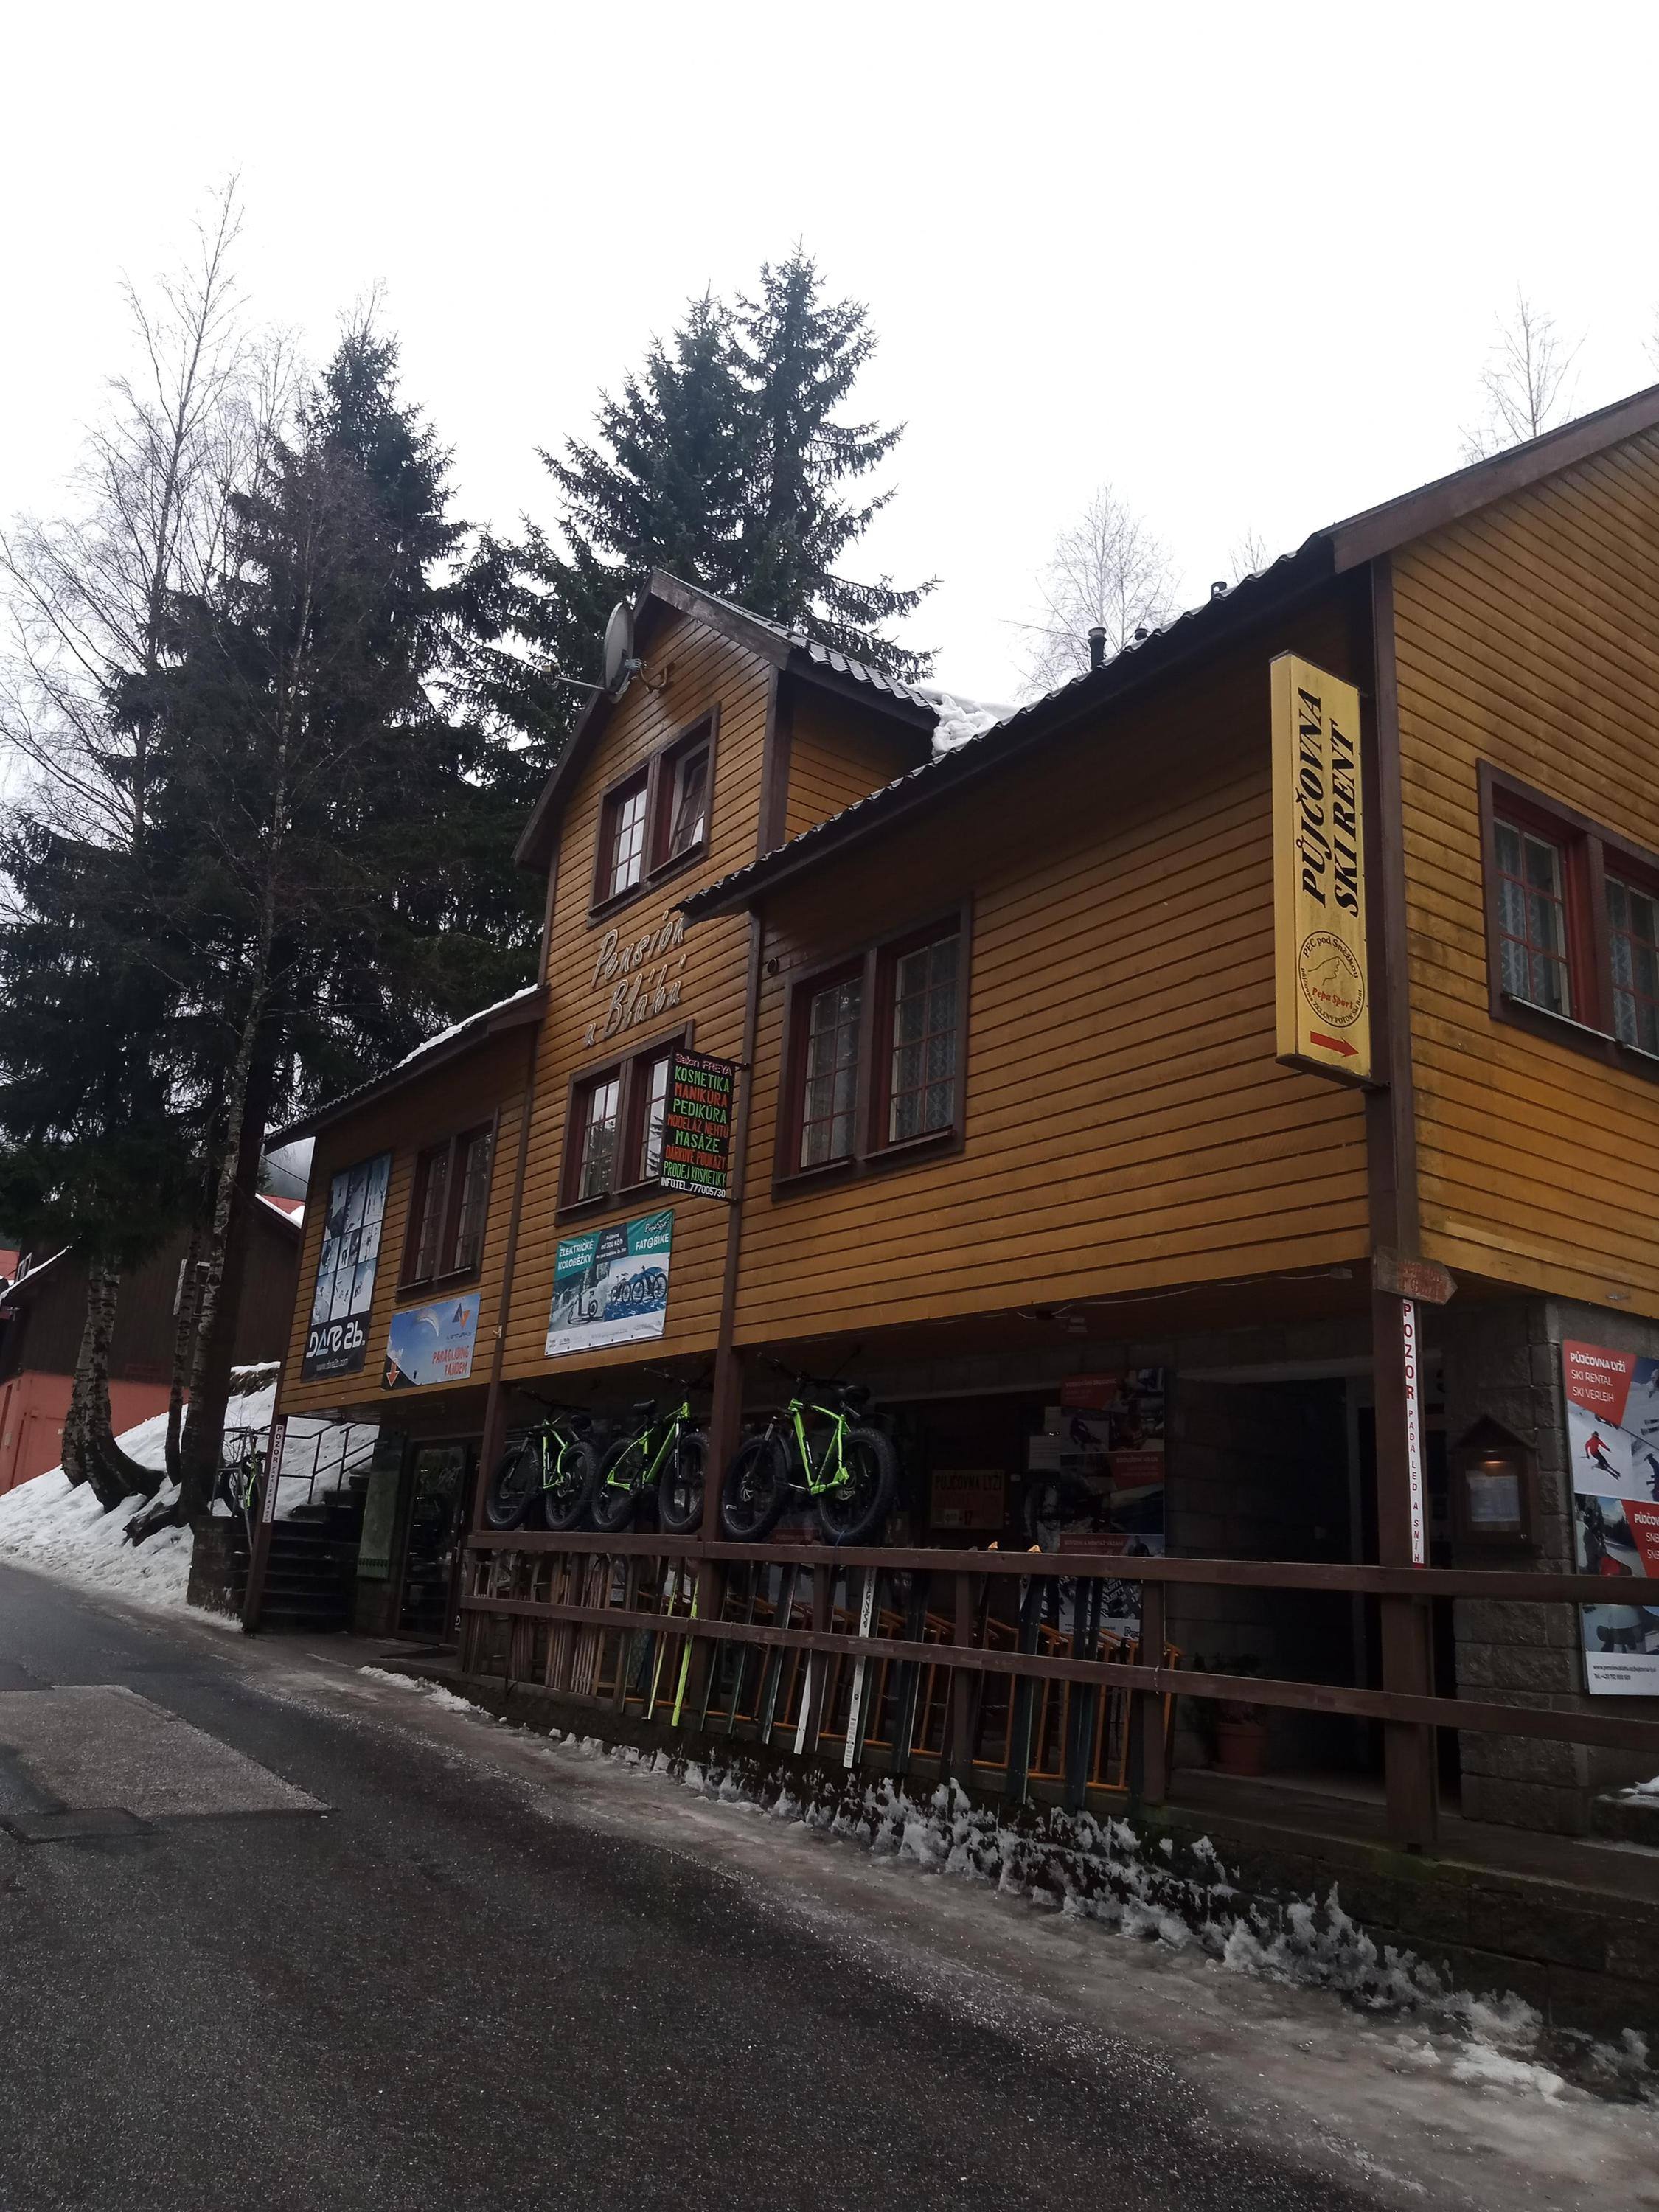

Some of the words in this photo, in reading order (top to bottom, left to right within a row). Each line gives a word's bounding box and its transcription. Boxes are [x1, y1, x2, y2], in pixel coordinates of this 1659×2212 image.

[1329, 717, 1355, 842] RENT
[1295, 687, 1332, 908] PŮJČOVNA
[1334, 835, 1358, 917] SKI
[1303, 938, 1316, 958] PEC
[1317, 936, 1332, 946] pod
[1332, 939, 1359, 978] Sněžkou
[1312, 987, 1332, 1002] Pepa
[1332, 993, 1354, 1009] Sport
[675, 1054, 700, 1068] Salon
[674, 1065, 730, 1093] KOSMETIKA
[675, 1130, 720, 1153] MASÁŽE
[663, 1161, 690, 1180] PRODEJ
[691, 1166, 726, 1187] KOSMETIKY
[1403, 1303, 1415, 1400] POZOR
[1570, 1350, 1610, 1369] PŮJČOVNA
[1610, 1360, 1626, 1373] LYŽÍ
[1571, 1369, 1584, 1380] SKI
[1585, 1371, 1613, 1387] RENTAL
[1572, 1386, 1585, 1398] SKI
[1585, 1388, 1615, 1403] VERLEIH
[273, 1426, 282, 1464] POZOR
